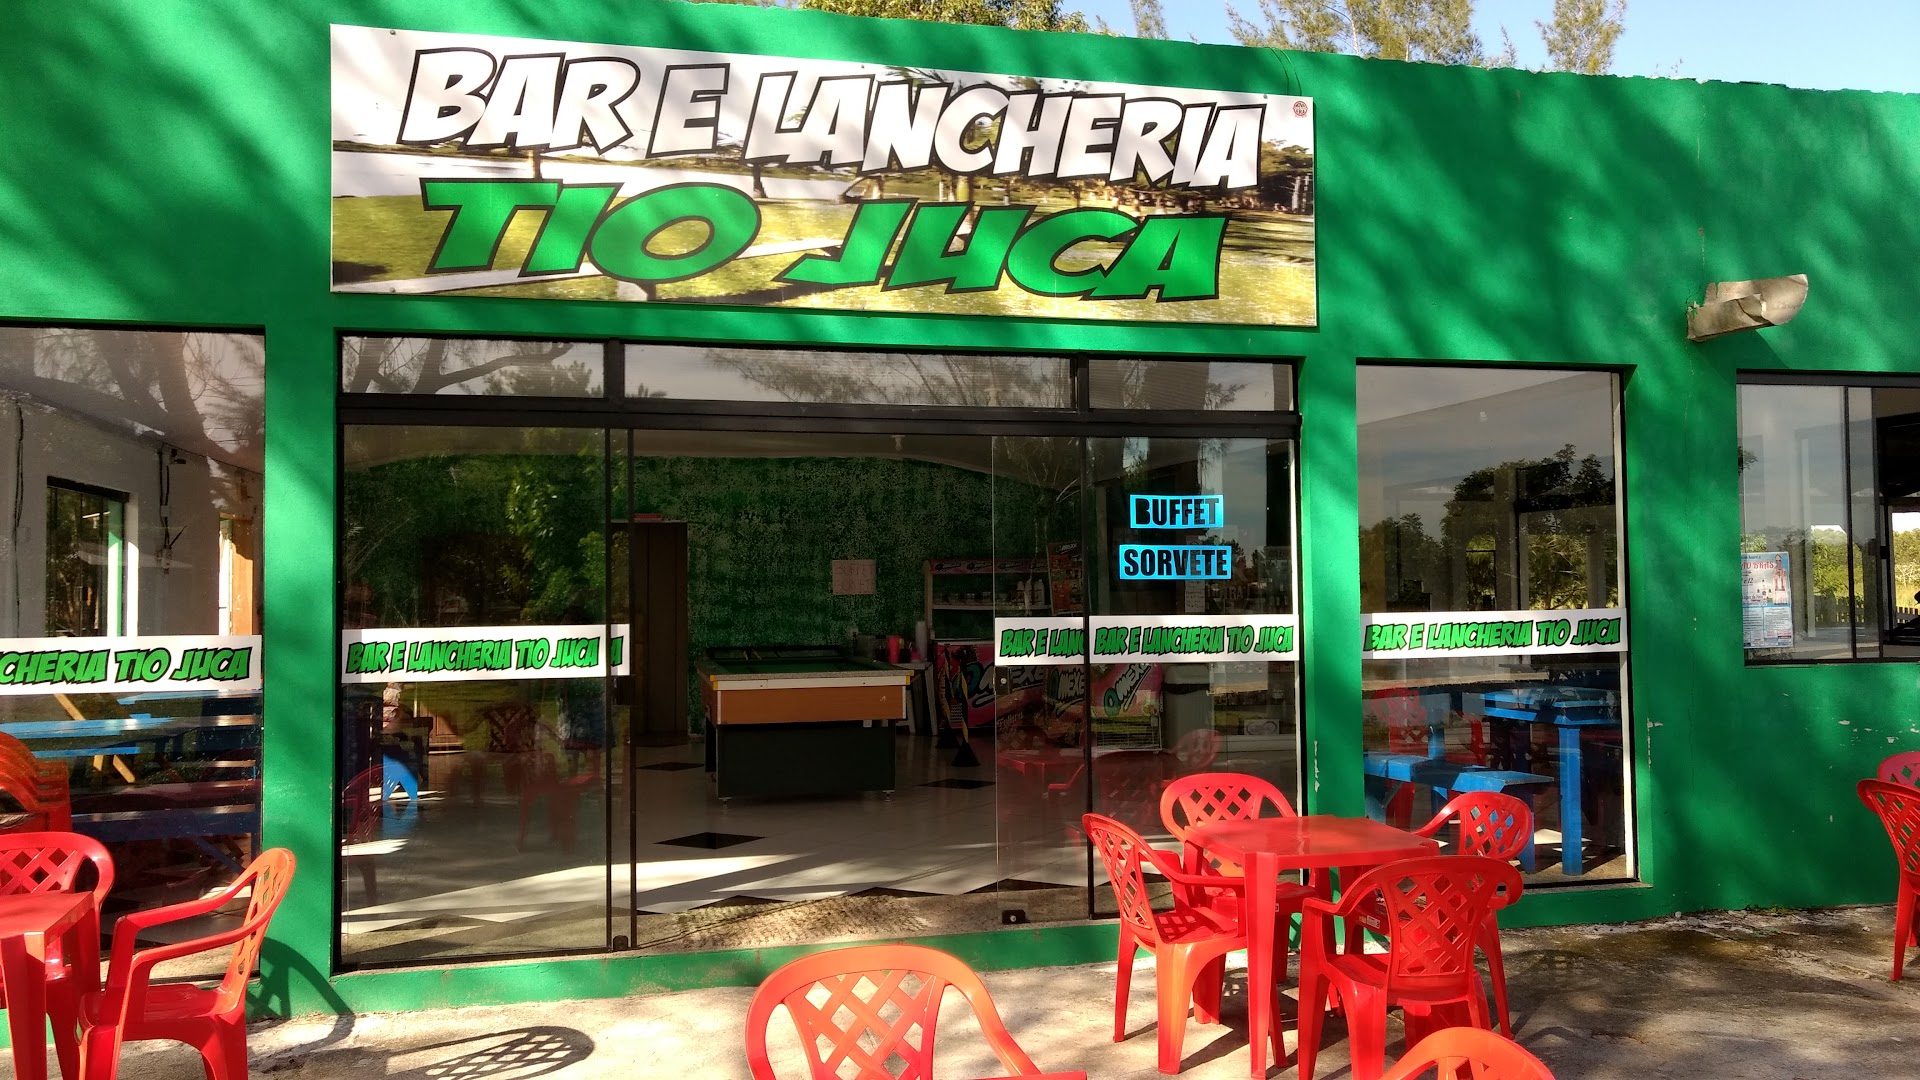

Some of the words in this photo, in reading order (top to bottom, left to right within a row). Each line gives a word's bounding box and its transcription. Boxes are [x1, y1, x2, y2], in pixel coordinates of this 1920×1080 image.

[397, 48, 640, 156] BAR
[647, 63, 730, 159] E
[741, 71, 1267, 190] LANCHERIA
[419, 178, 762, 283] TIO
[771, 197, 1230, 303] JUCA
[1135, 497, 1220, 526] BUFFET
[1124, 548, 1228, 577] SORVETE
[1000, 628, 1036, 658] BAR
[1034, 628, 1049, 656] E
[1094, 626, 1128, 656] BAR
[1127, 626, 1142, 654] E
[1141, 625, 1226, 656] LANCHERIA
[1226, 625, 1255, 654] TIO
[1254, 625, 1294, 654] JUCA
[1363, 621, 1408, 651] BAR
[1408, 622, 1425, 650] E
[1425, 620, 1534, 650] LANCHERIA
[1536, 618, 1571, 648] TIO
[1570, 617, 1621, 646] JUCA
[114, 646, 171, 683] TIO
[169, 646, 252, 682] JUCA
[346, 641, 390, 674] BAR
[389, 641, 406, 672] E
[406, 639, 513, 672] LANCHERIA
[515, 637, 551, 670] TIO
[549, 636, 601, 668] JUCA
